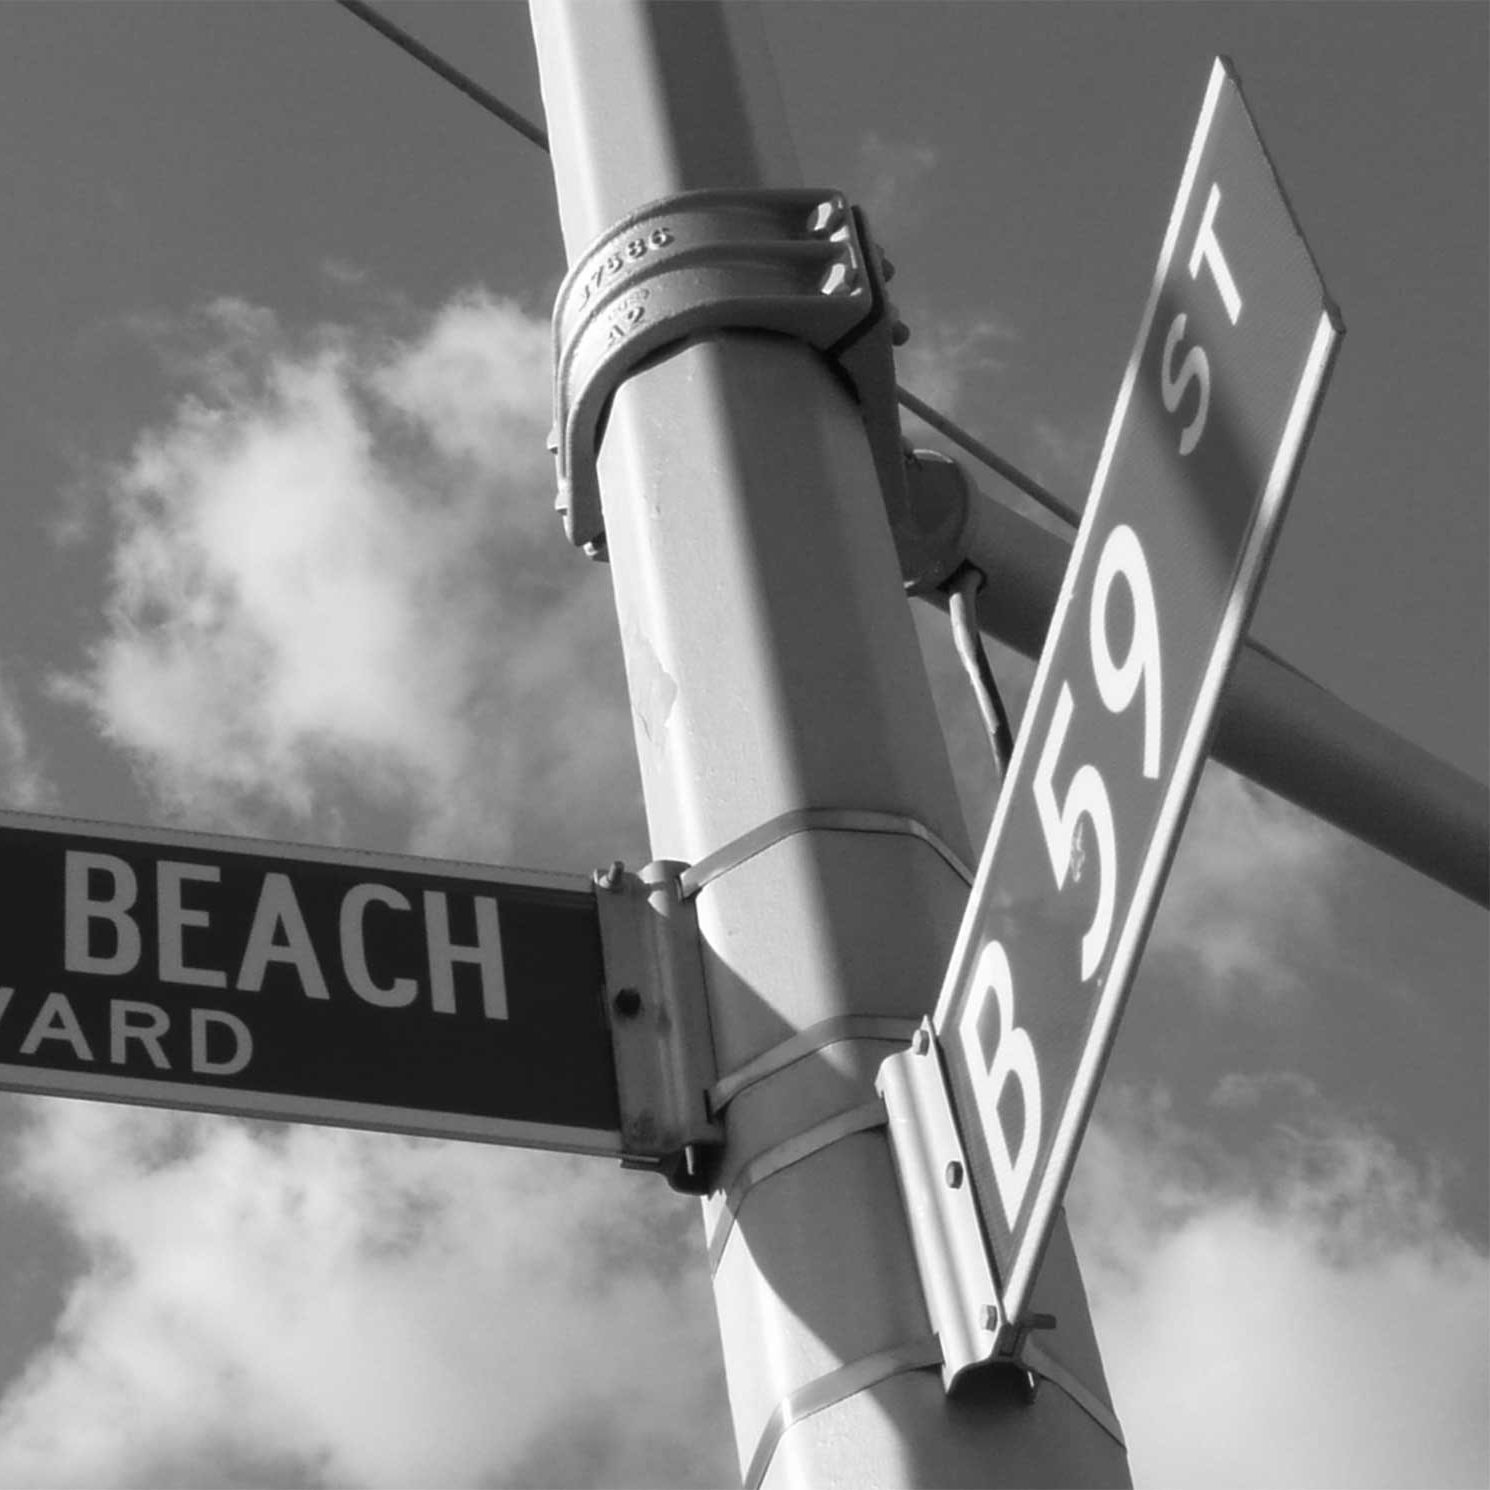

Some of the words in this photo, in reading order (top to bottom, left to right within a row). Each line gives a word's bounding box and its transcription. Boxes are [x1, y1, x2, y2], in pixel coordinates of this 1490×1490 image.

[64, 849, 510, 1021] BEACH
[959, 940, 1042, 1234] B
[1033, 524, 1162, 983] 59
[1161, 181, 1243, 456] ST
